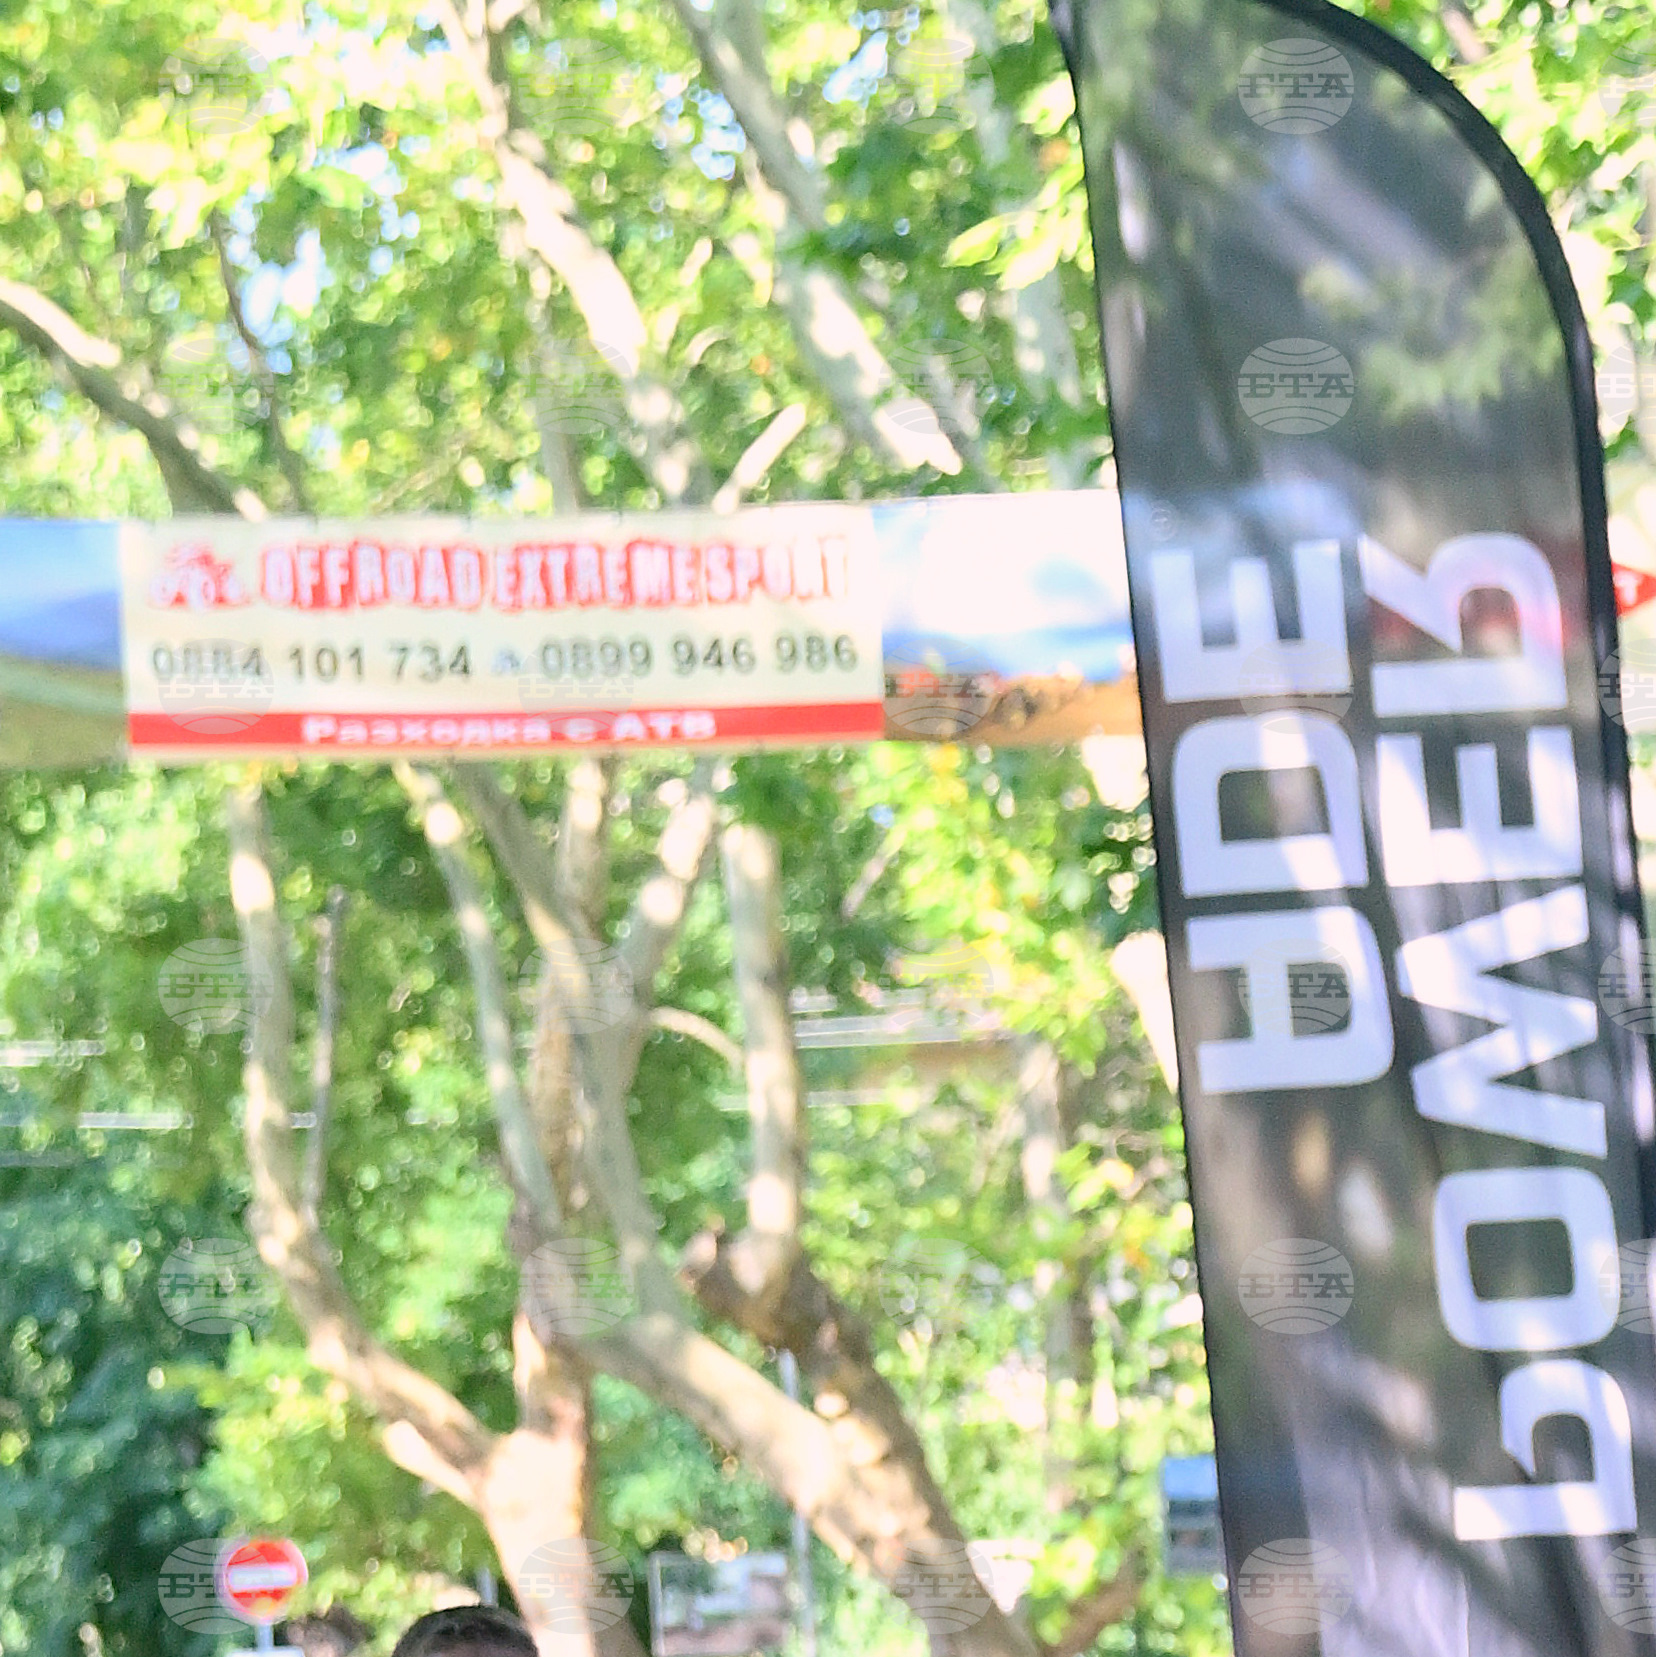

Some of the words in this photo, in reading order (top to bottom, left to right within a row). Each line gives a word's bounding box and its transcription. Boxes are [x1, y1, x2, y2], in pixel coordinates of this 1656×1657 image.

[261, 541, 483, 610] OFFROAD
[494, 540, 697, 610] EXTREME
[289, 645, 366, 682] 101
[390, 643, 473, 683] 734
[539, 635, 653, 677] 0899
[673, 636, 756, 675] 946
[776, 634, 859, 673] 986
